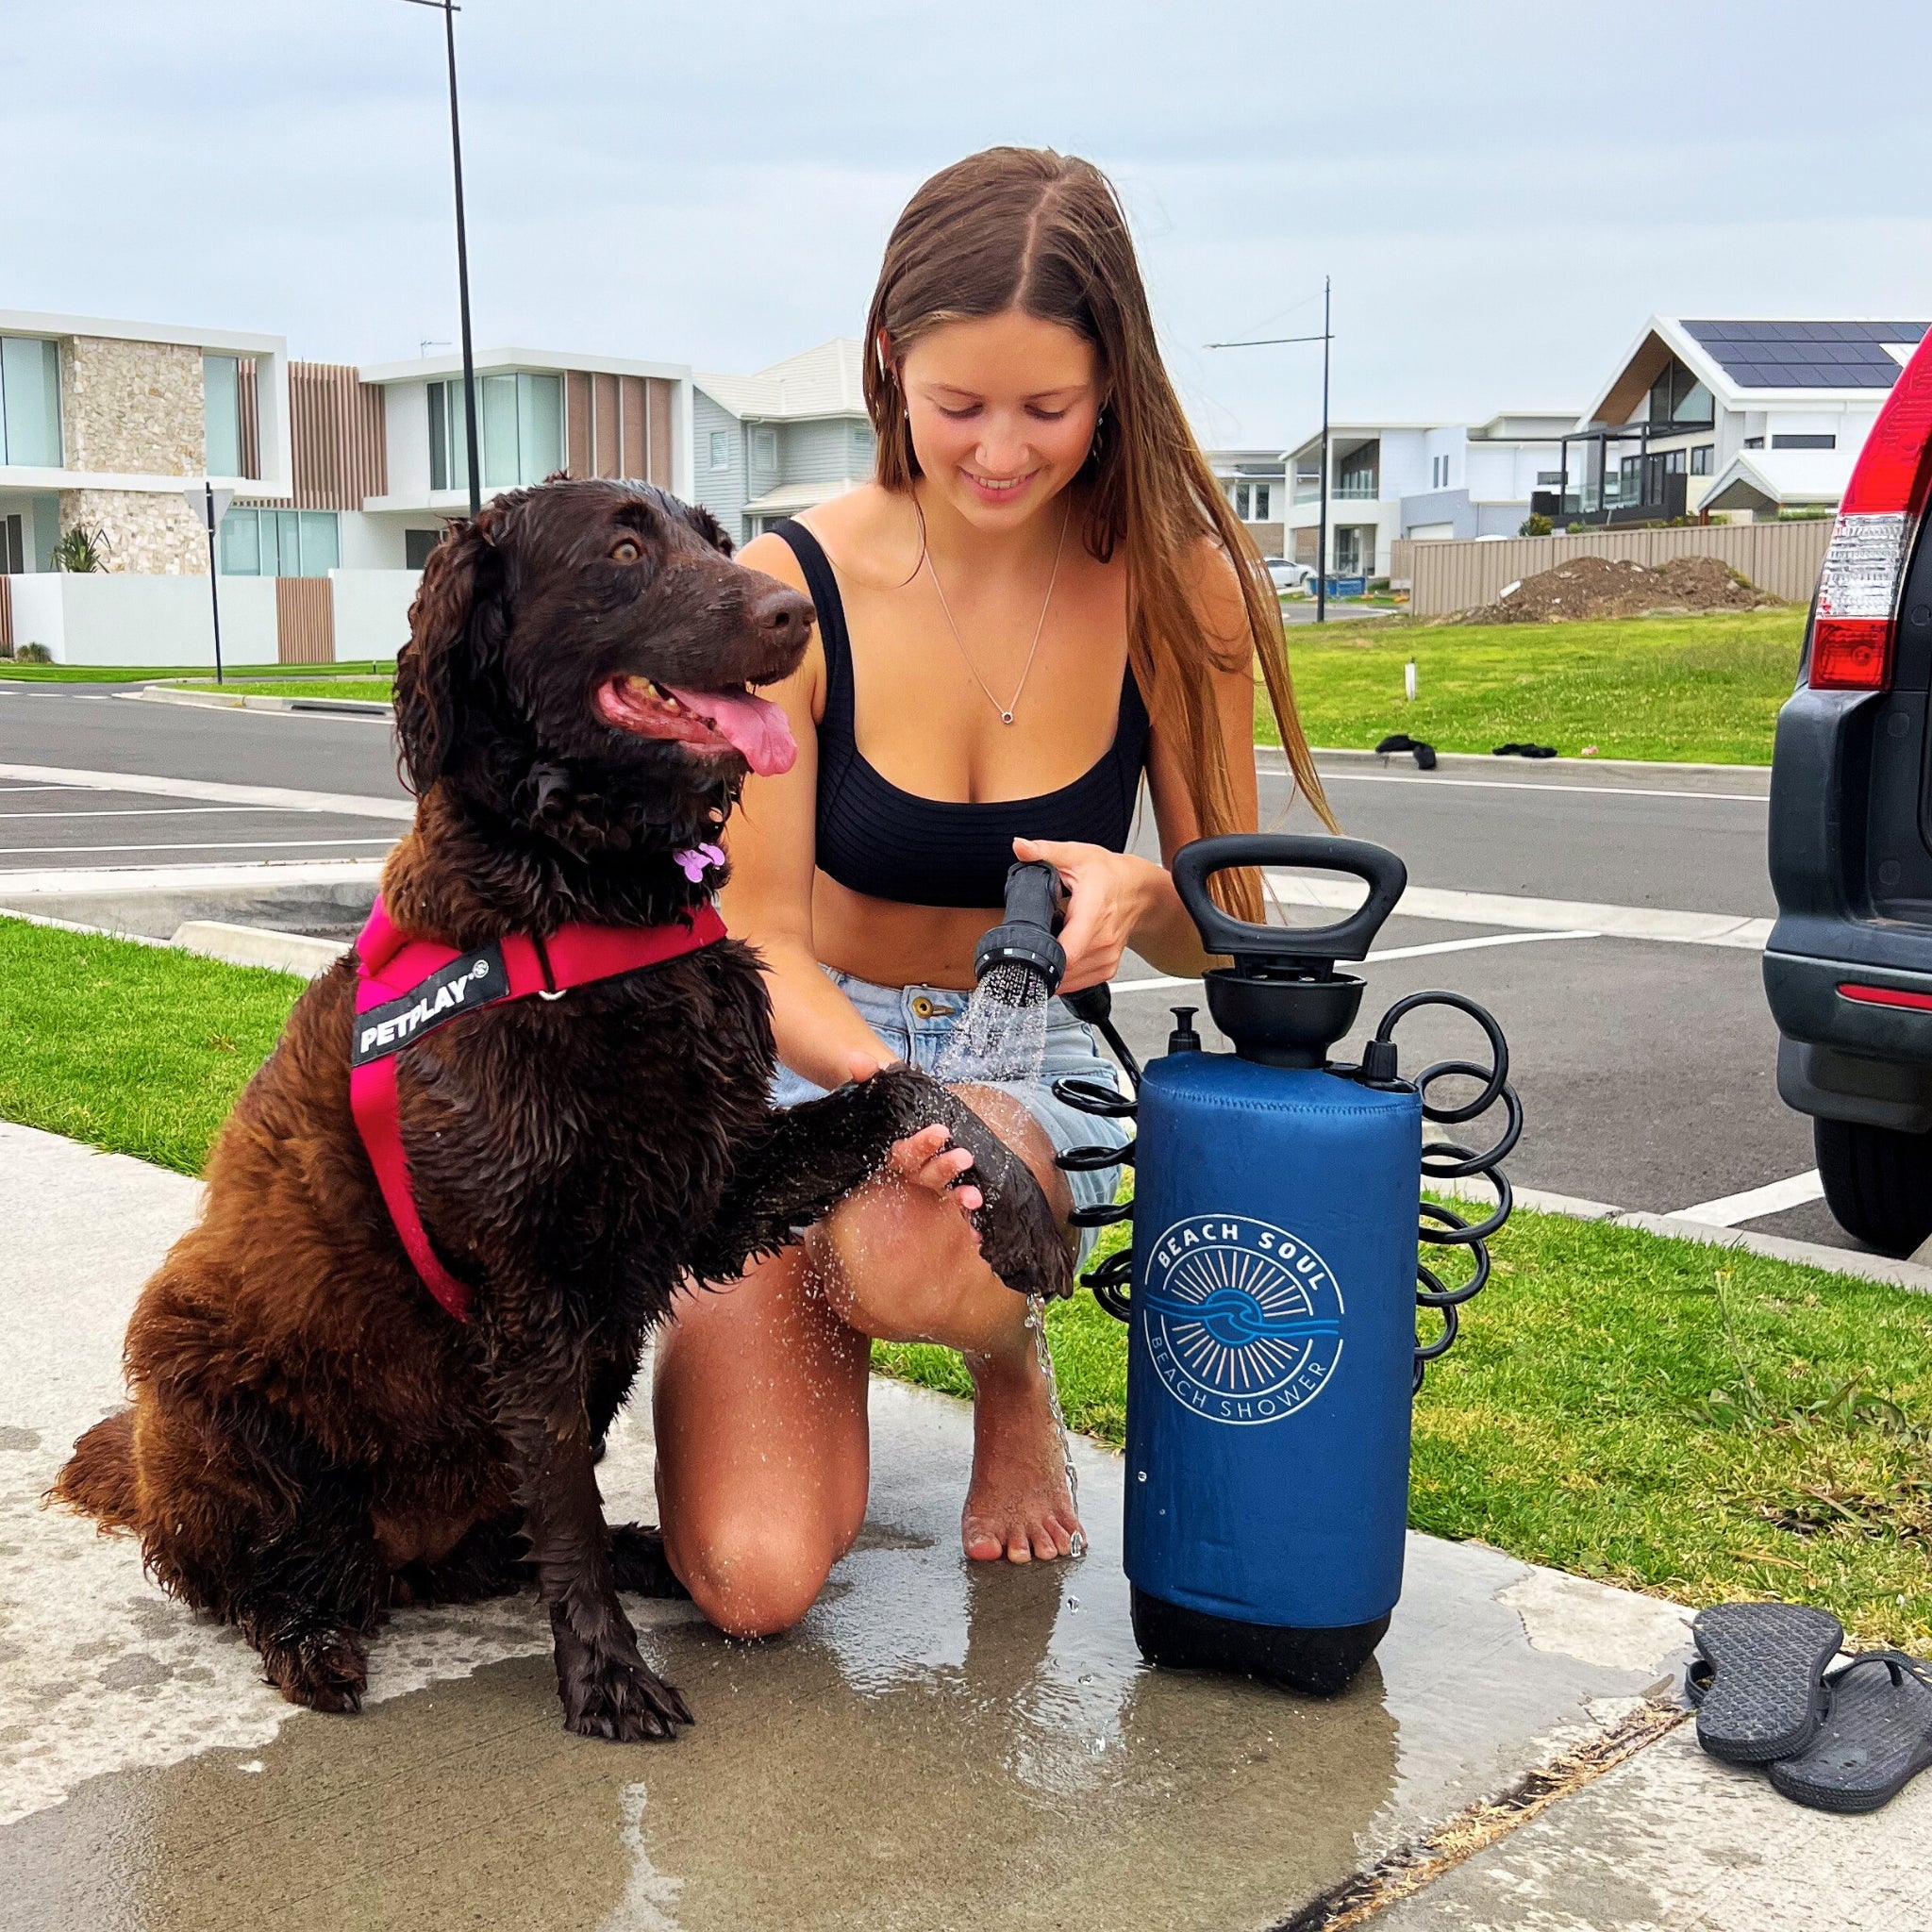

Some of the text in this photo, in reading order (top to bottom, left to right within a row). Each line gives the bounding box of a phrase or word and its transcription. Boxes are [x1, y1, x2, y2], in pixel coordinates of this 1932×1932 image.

[1158, 1224, 1325, 1291] BEACH SOUL
[1151, 1337, 1327, 1418] BEACH SHOWER
